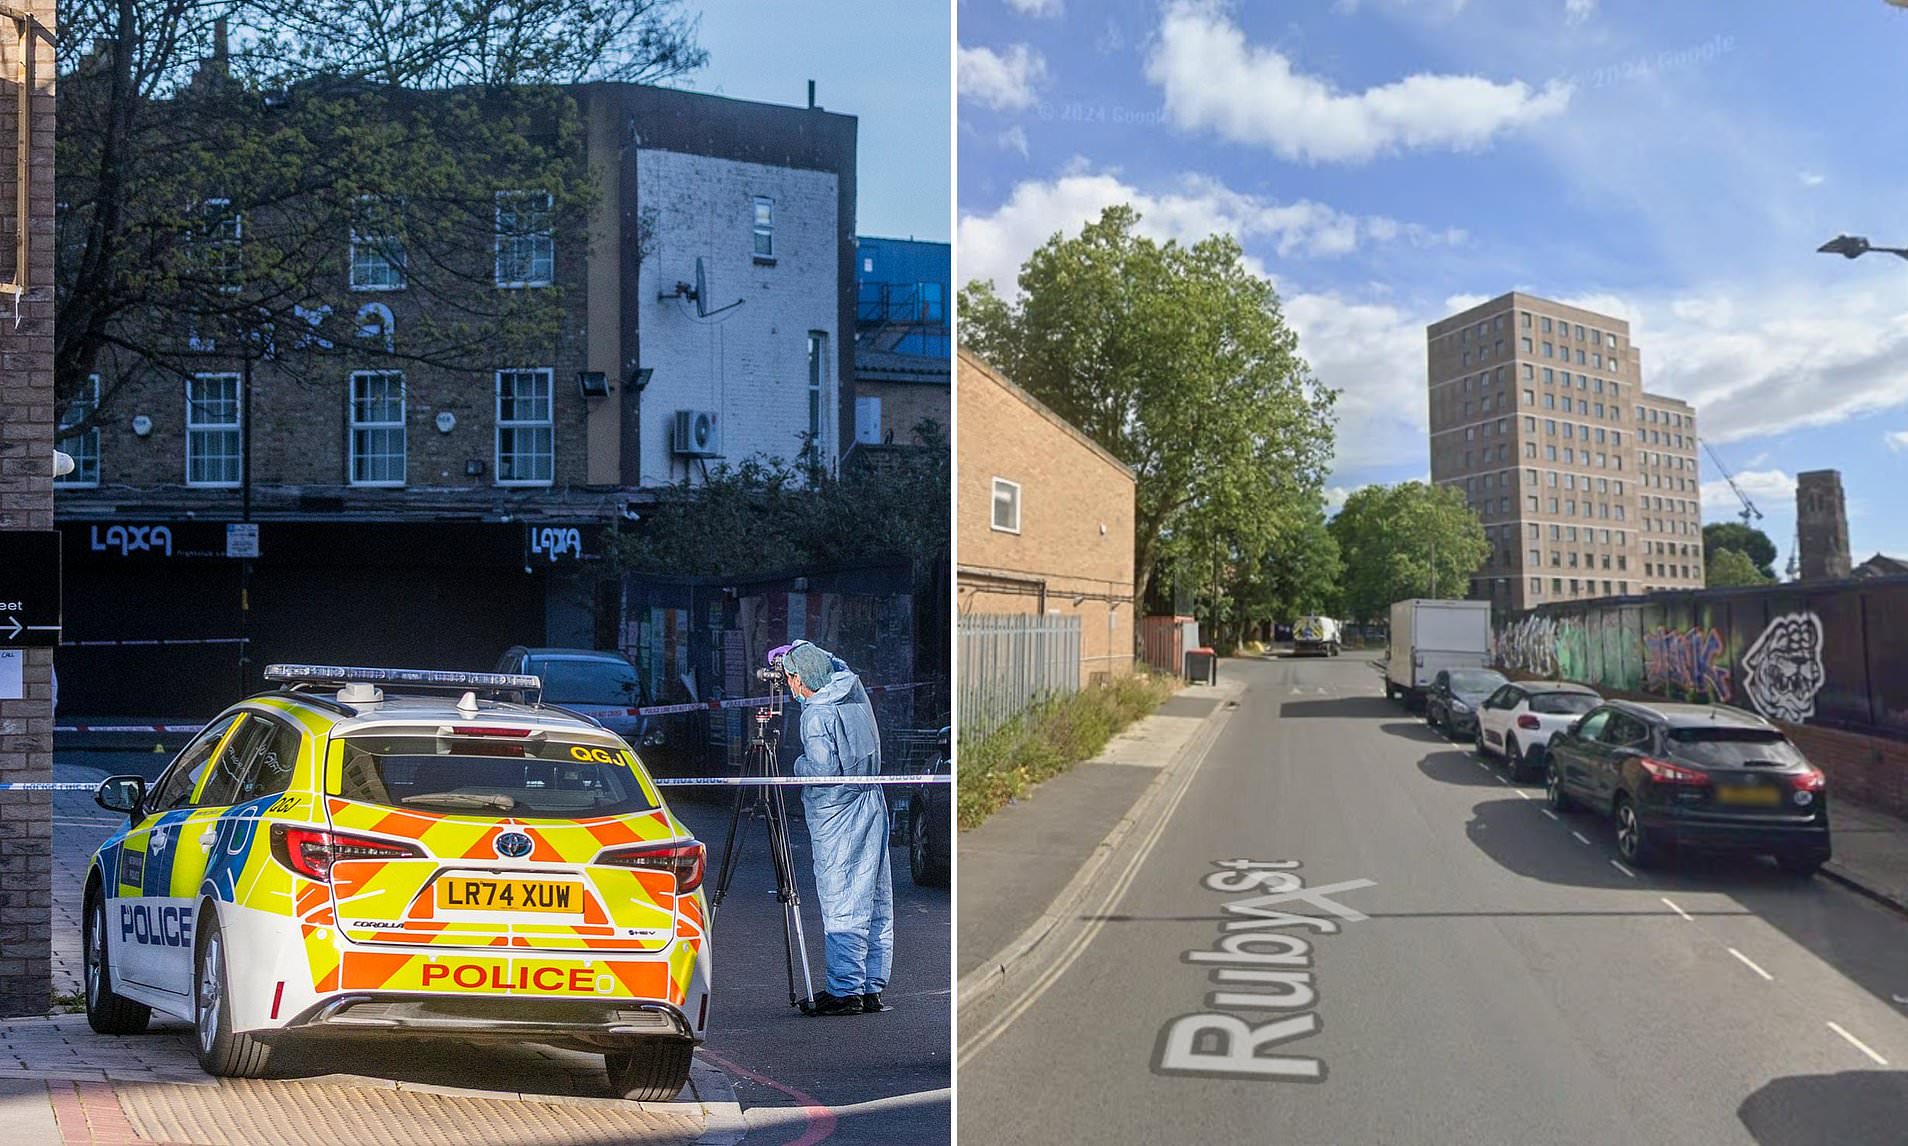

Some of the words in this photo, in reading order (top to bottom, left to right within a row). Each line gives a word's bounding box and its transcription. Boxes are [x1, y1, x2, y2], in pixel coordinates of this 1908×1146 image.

[570, 746, 626, 767] QGJ
[269, 796, 303, 813] QGJ
[447, 881, 514, 908] LR74
[521, 882, 571, 909] XUW
[120, 904, 193, 948] POLICE
[352, 920, 405, 929] COROLLA
[421, 963, 595, 993] POLICE
